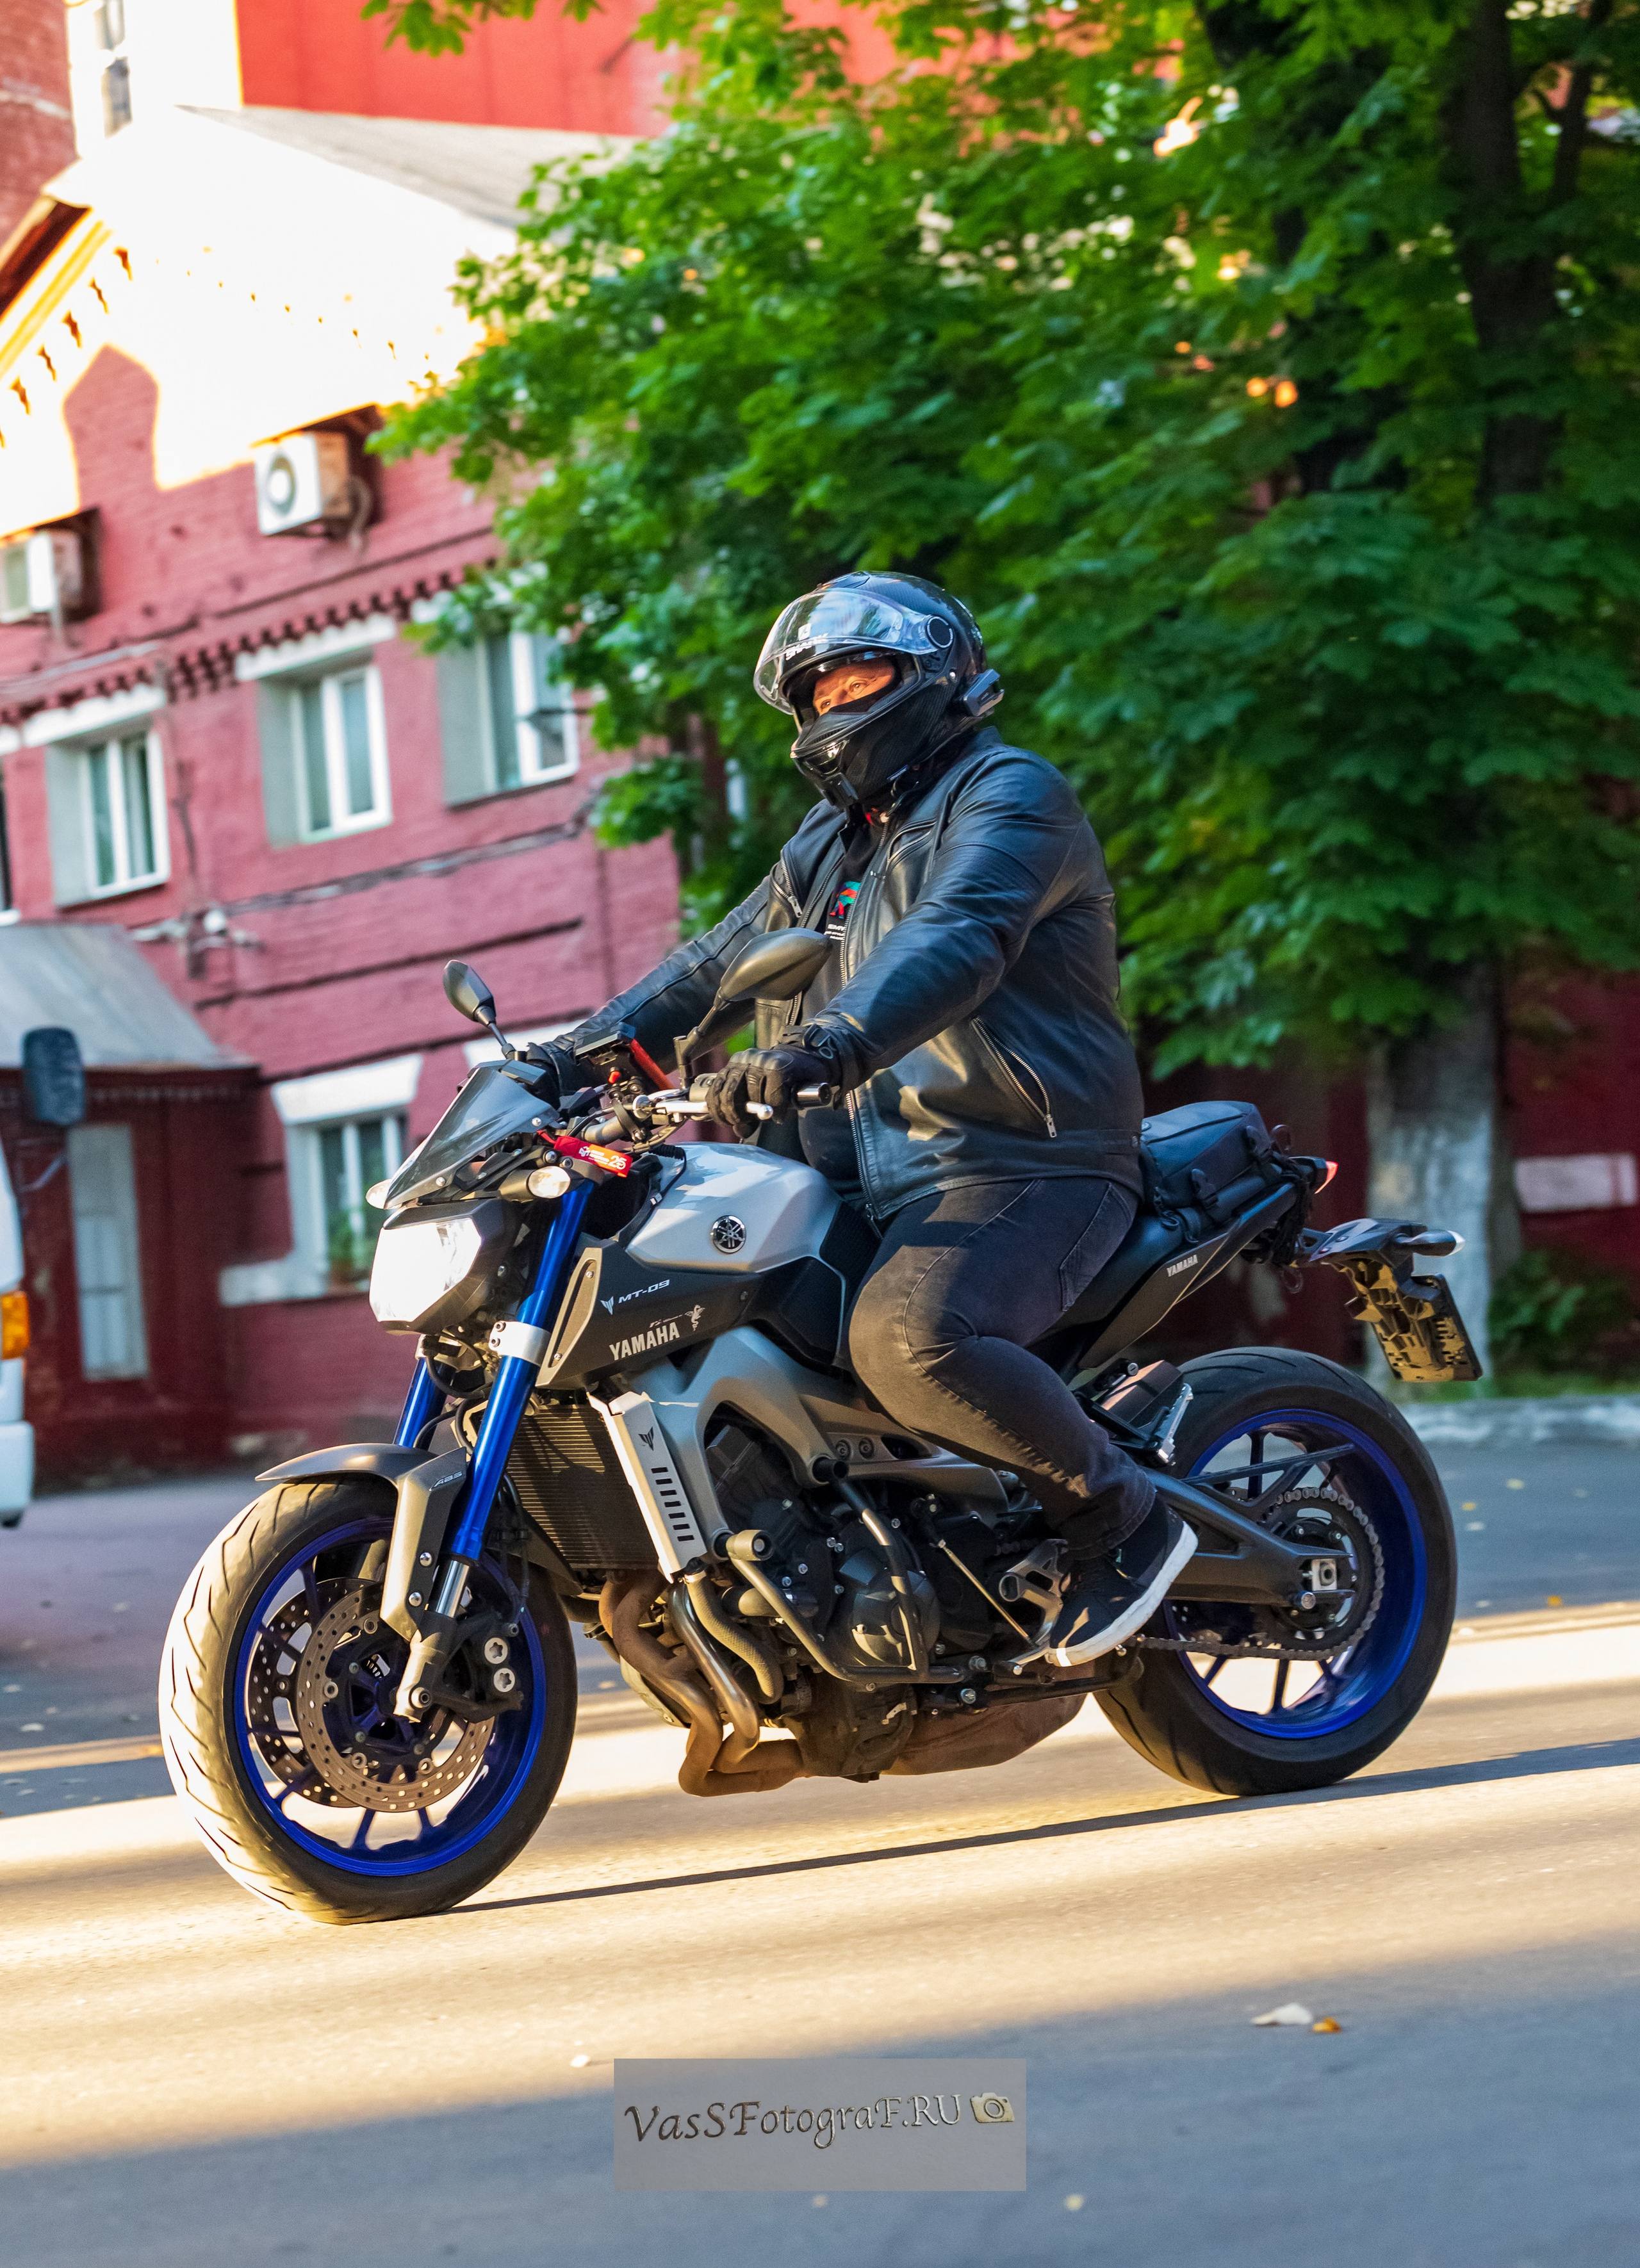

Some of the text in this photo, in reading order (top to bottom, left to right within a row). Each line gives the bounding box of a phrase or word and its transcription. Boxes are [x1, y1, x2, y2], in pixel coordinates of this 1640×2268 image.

[1167, 1254, 1198, 1277] YAMAHA
[618, 1280, 670, 1303] MT-09
[609, 1322, 680, 1360] YAMAHA
[432, 1471, 463, 1487] ABS
